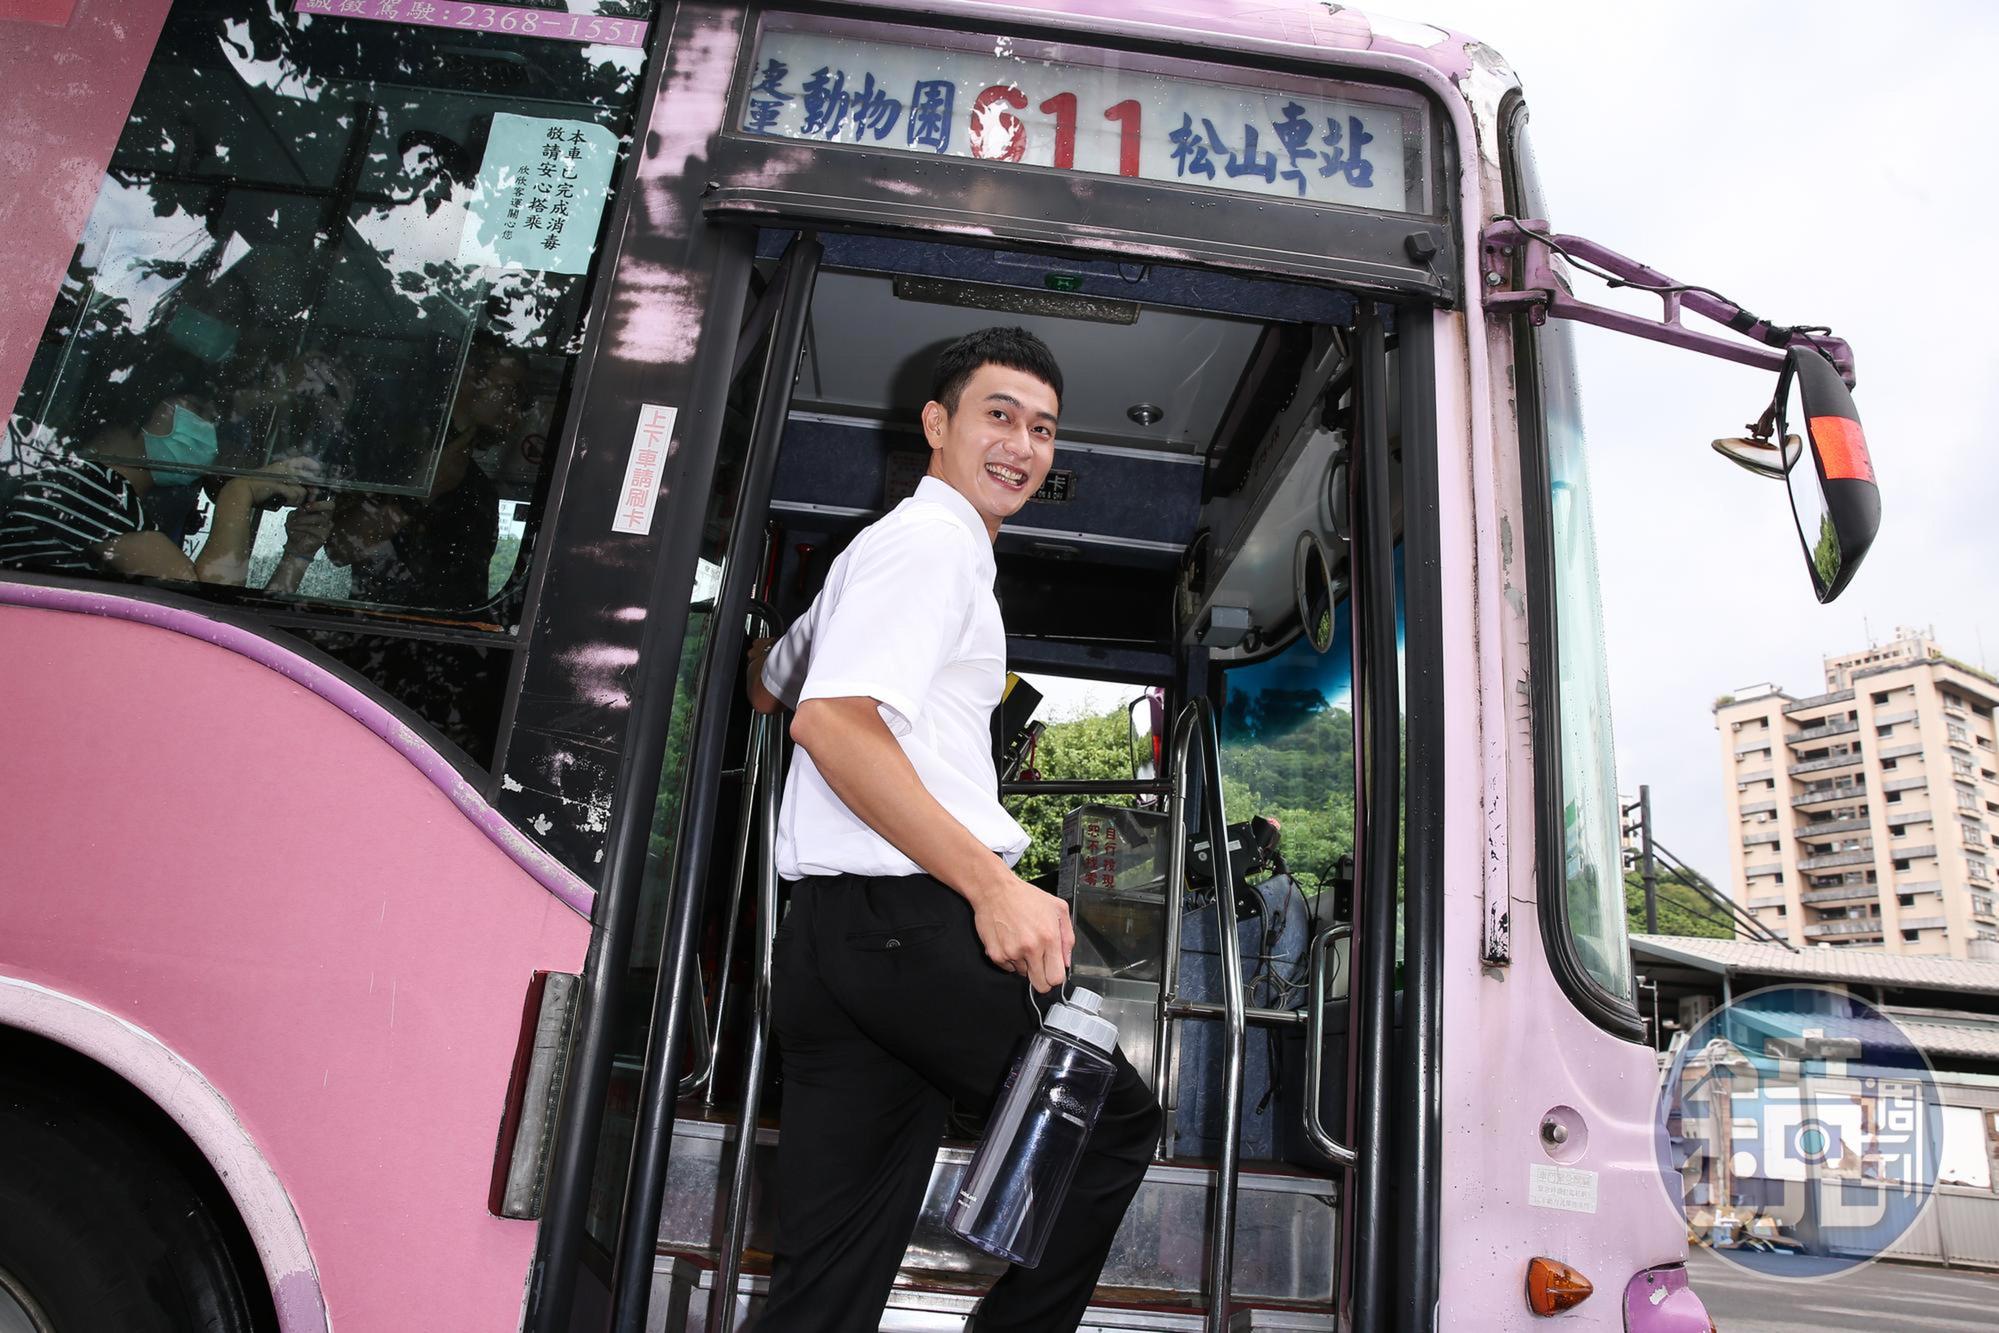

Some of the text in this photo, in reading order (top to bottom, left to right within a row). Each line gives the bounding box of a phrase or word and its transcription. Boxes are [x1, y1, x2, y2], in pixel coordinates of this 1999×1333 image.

[523, 126, 566, 230] 敬請安心搭乘
[969, 84, 1142, 177] 611
[1168, 101, 1374, 195] 松山車站
[501, 165, 530, 241] 欣欣客運關心您
[540, 129, 587, 251] 本車已完成消毒
[622, 409, 667, 528] 上下車請刷卡
